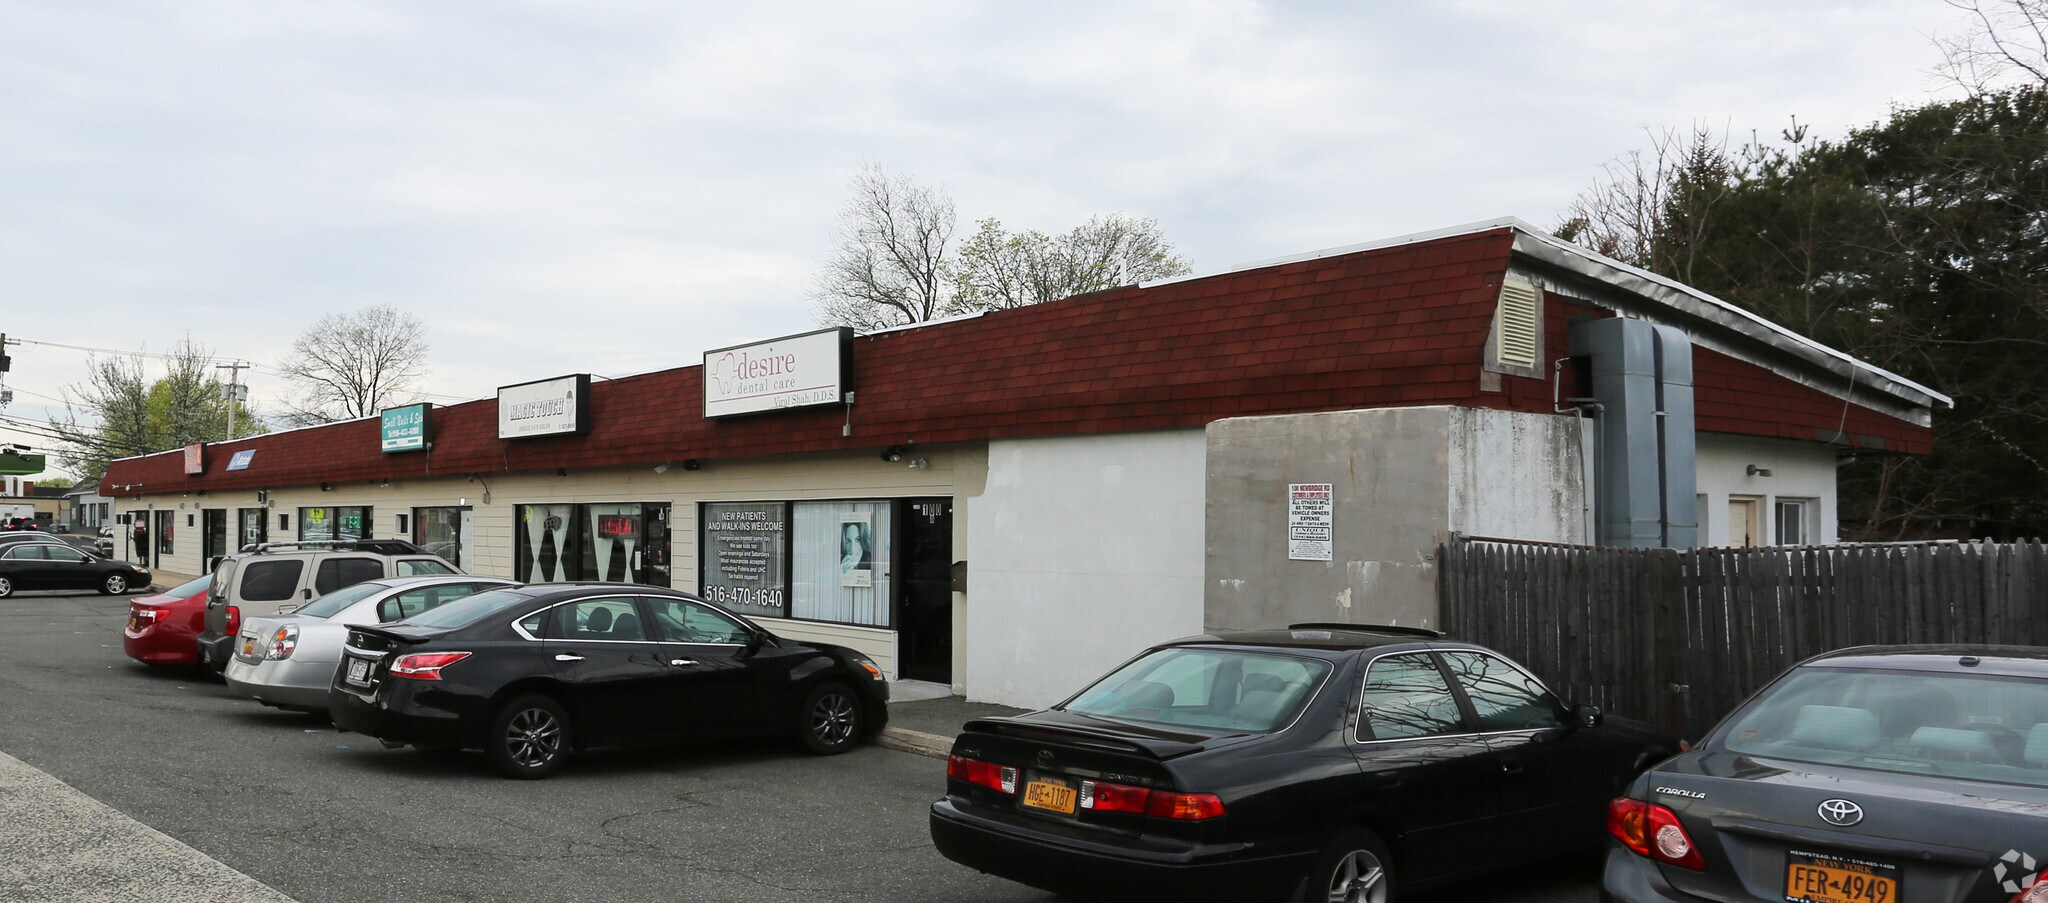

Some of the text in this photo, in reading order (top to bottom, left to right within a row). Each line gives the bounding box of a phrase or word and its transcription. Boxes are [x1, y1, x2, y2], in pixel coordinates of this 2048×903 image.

[737, 347, 795, 380] desire
[737, 378, 796, 394] dental care
[774, 395, 790, 407] Viral
[813, 390, 836, 402] D.D.S.
[510, 398, 564, 421] MAGIC TOUCH
[722, 511, 766, 520] NEW PATIENTS
[708, 521, 783, 531] AND WALK-INS WELCOME
[706, 585, 782, 607] 516-470-1640
[1028, 783, 1070, 807] HGE 1187
[1656, 787, 1706, 799] COROLLA
[1815, 859, 1872, 874] NEW YORK
[1794, 867, 1888, 903] FER 4949
